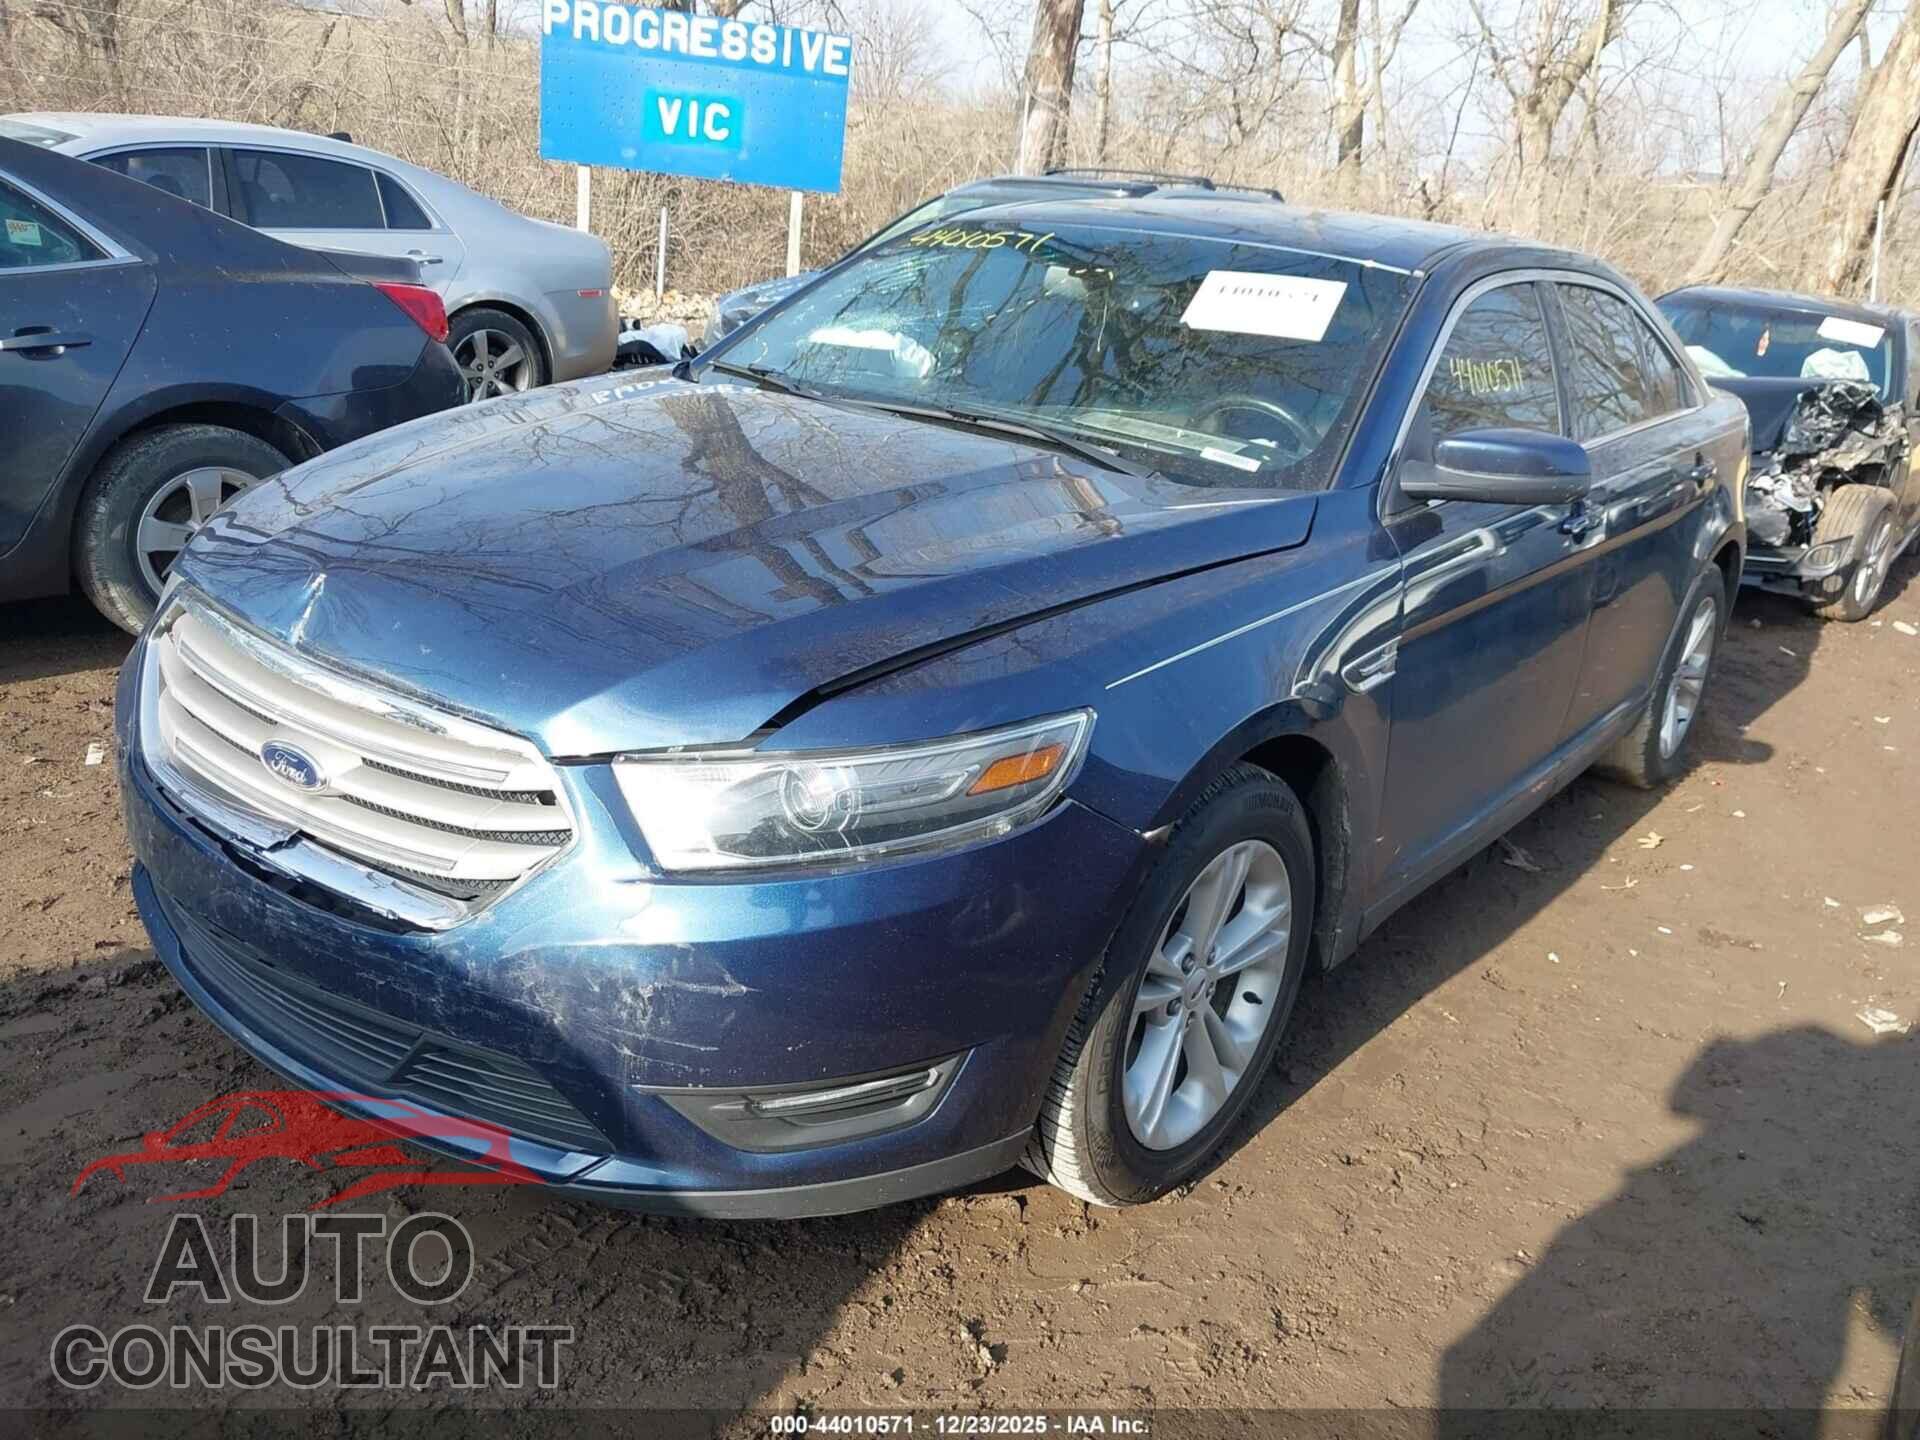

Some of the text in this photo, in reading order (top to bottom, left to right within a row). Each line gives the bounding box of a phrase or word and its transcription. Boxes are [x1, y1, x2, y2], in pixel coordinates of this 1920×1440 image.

[543, 0, 850, 76] PROGRESSIVE
[657, 96, 731, 141] VIC
[910, 228, 1055, 252] 44010571
[1449, 356, 1525, 396] 44010571
[271, 750, 308, 783] Ford
